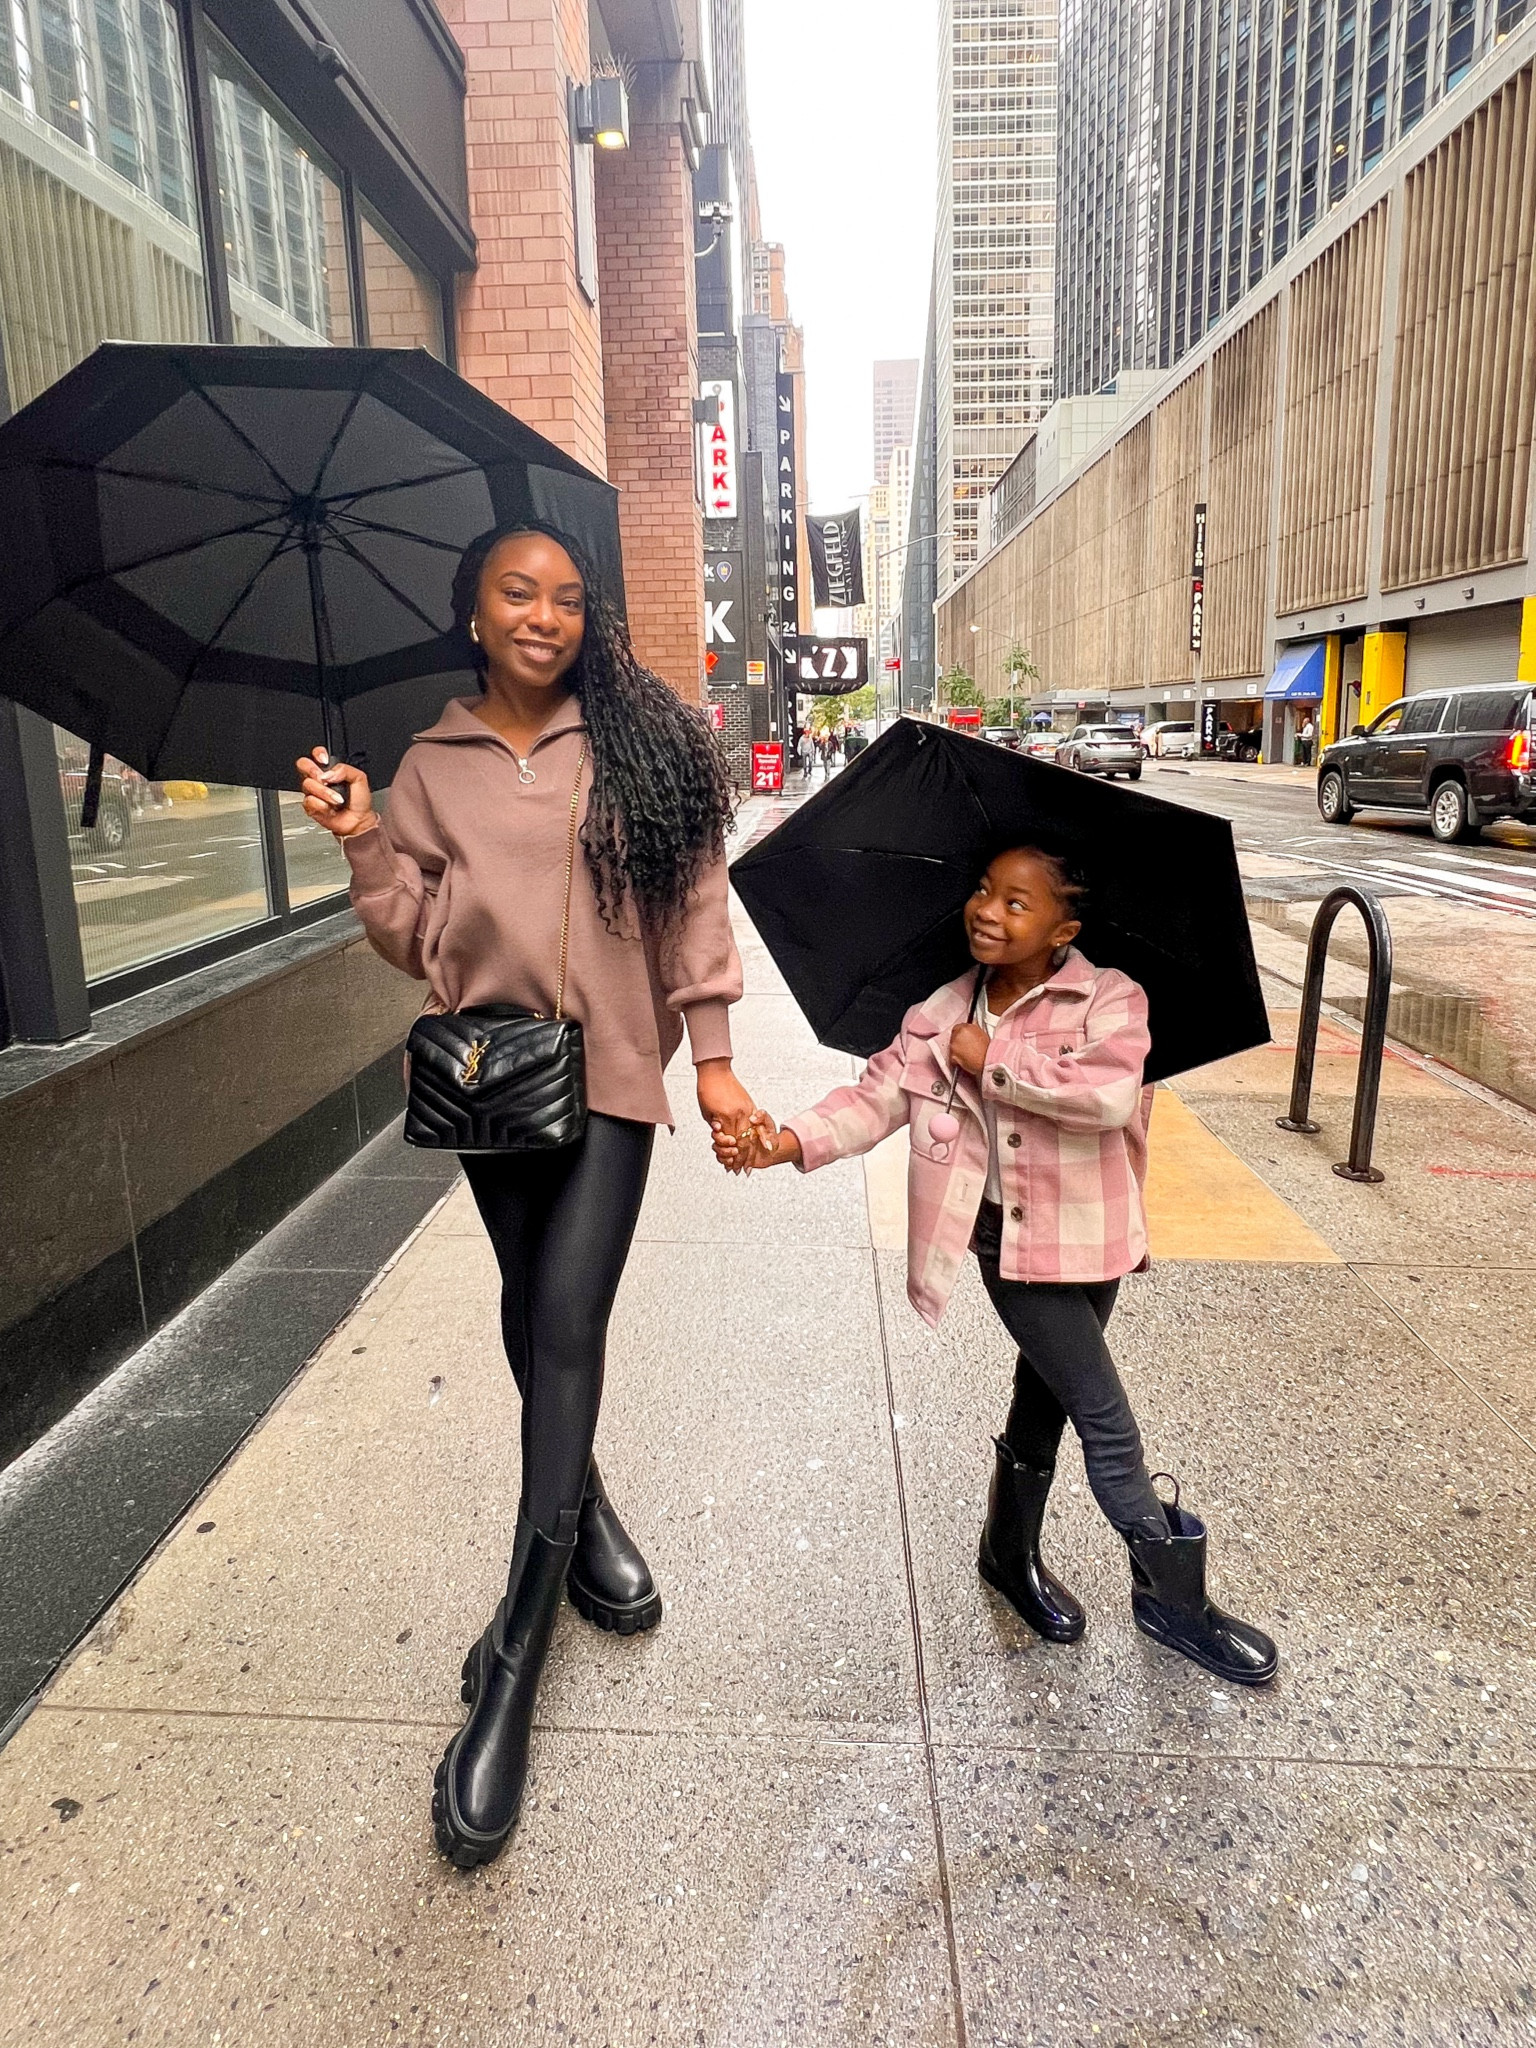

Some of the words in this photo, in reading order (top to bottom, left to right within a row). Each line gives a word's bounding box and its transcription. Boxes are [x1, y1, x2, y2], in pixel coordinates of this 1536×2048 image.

[711, 401, 728, 490] ARK
[779, 429, 795, 602] PARKING
[823, 521, 846, 607] ZIEGFELD
[782, 621, 797, 632] 24
[1192, 591, 1203, 637] PARK
[1205, 707, 1214, 735] PARK
